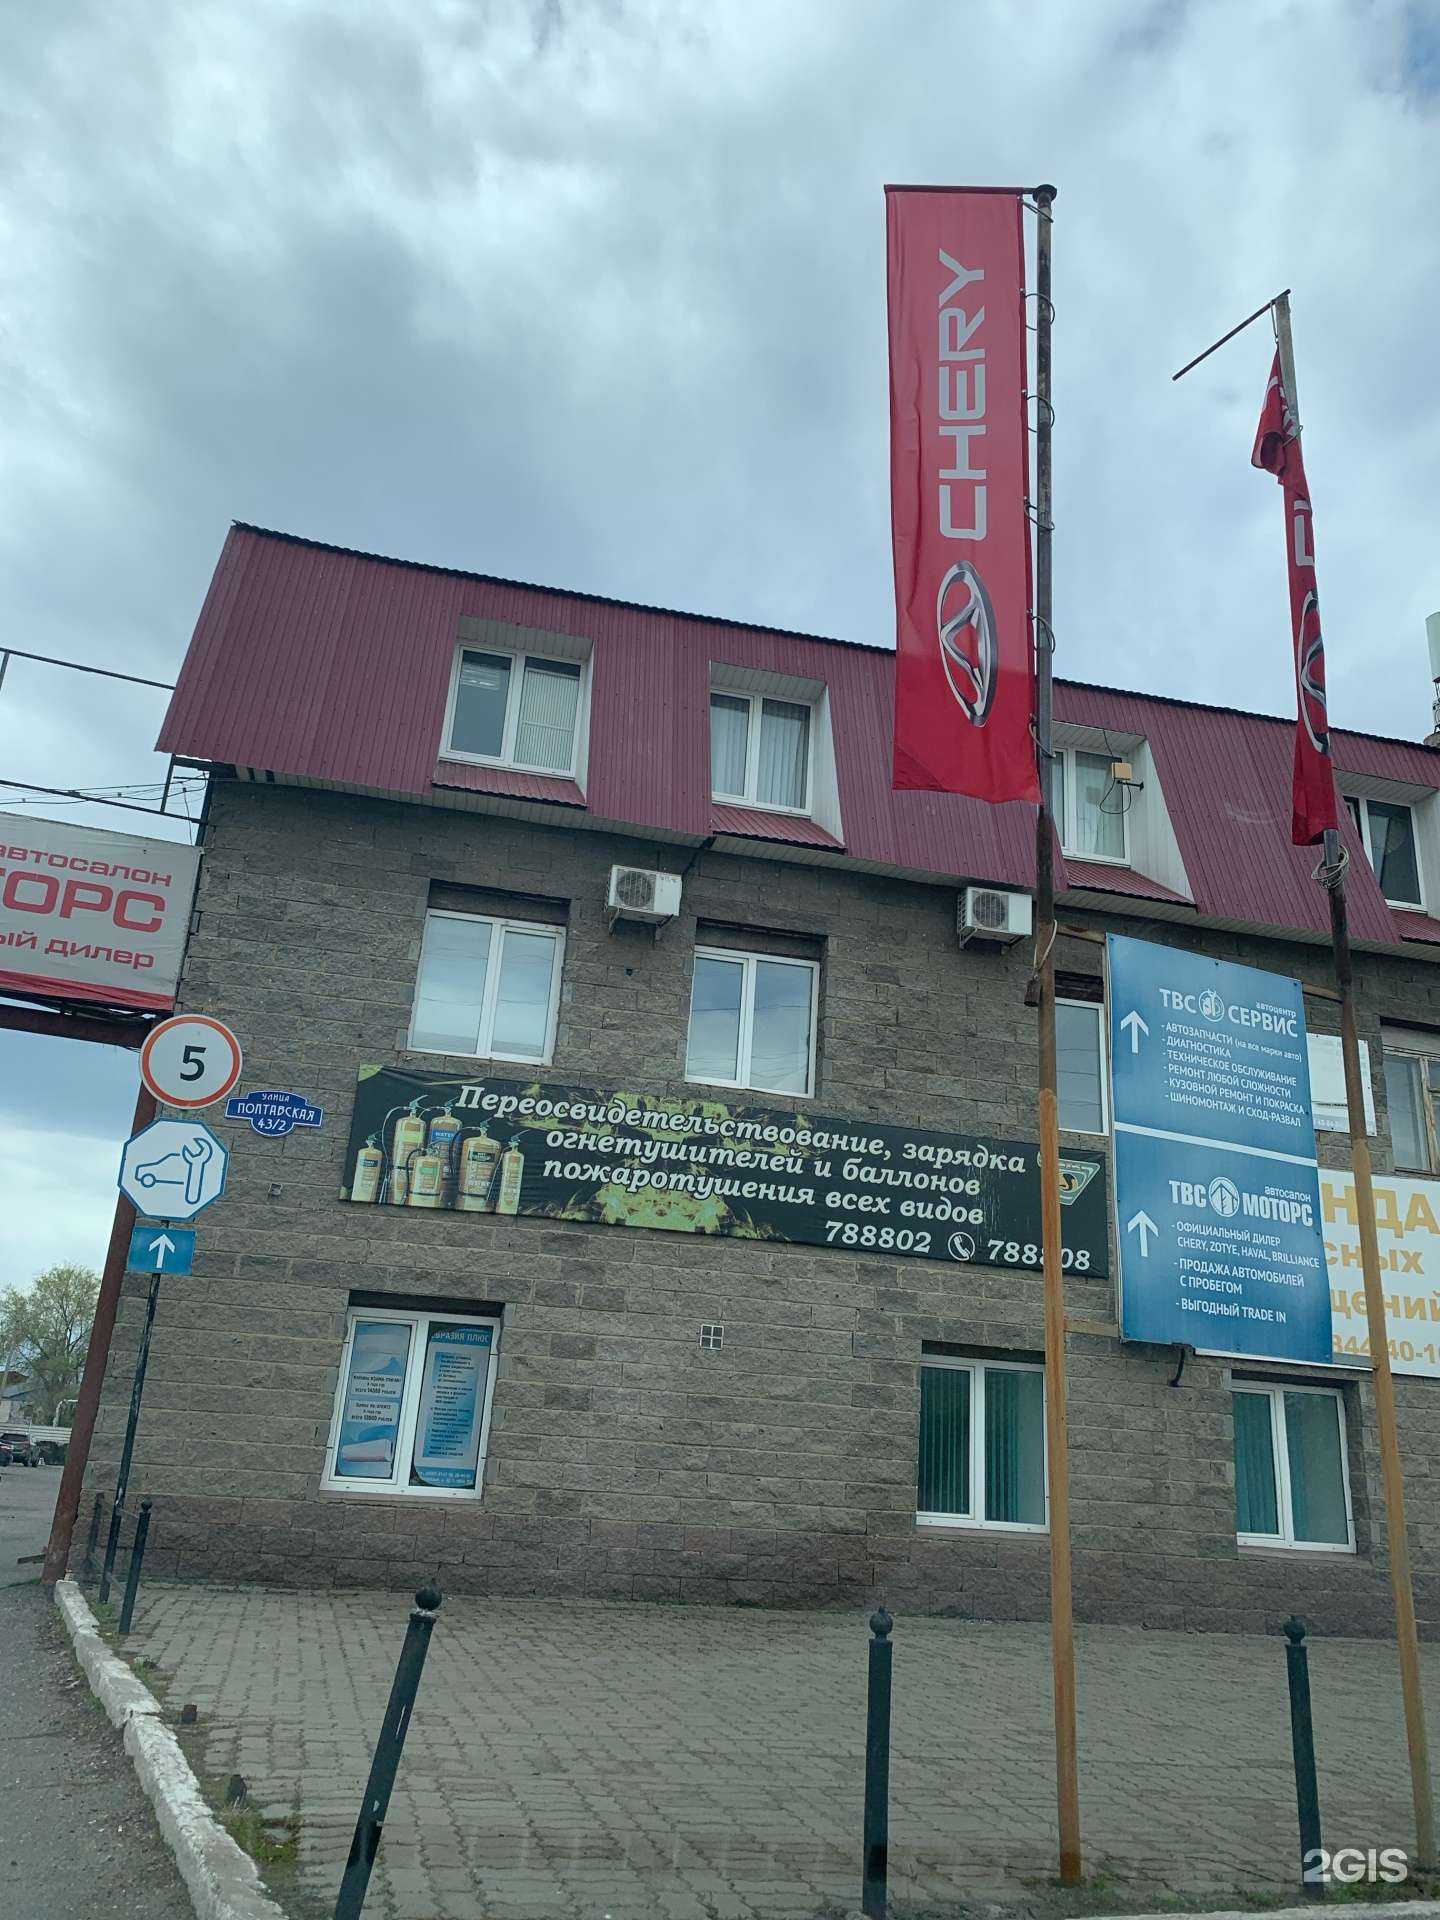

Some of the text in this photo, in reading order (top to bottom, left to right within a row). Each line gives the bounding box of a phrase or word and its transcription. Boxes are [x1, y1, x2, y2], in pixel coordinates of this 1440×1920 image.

[938, 247, 988, 541] CHERY
[0, 844, 173, 887] втосалон
[0, 867, 166, 933] ОРС
[44, 937, 155, 970] дилер
[1158, 988, 1299, 1038] ТВС СЕРВИС
[1255, 1001, 1297, 1019] автоцентр
[1166, 1022, 1233, 1044] АВТОЗАПЧАСТИ
[1166, 1036, 1232, 1059] ДИАГНОСТИКА
[179, 1045, 207, 1081] 5
[1167, 1049, 1297, 1087] ТЕХНИЧЕСКОЕ ОБСЛУЖИВАНИЕ
[1168, 1063, 1291, 1098] РЕМОНТ ЛЮБОЙ СЛОЖНОСТИ
[237, 1102, 315, 1121] ПОЛТАВСКАЯ
[1169, 1077, 1305, 1115] КУЗОВНОЙ РЕМОНТ И ПОКРАСКА
[1170, 1091, 1236, 1113] ШИНОМОНТАЖ
[1238, 1105, 1245, 1115] И
[1246, 1106, 1302, 1128] СХОД-РАЗВАЛ
[257, 1117, 287, 1131] 43/2
[455, 1085, 1026, 1174] Переосвидетельствование, зарядка
[546, 1129, 982, 1197] огнетушителей и баллонов
[543, 1158, 984, 1225] пожаротушения всех видов
[1168, 1180, 1313, 1227] ТВС МОТОРС
[1264, 1185, 1311, 1202] автосалон
[824, 1220, 1091, 1271] 788802 78808
[1176, 1220, 1281, 1247] ОФИЦИАЛЬНЫЙ ДИЛЕР
[1177, 1236, 1320, 1269] CHERY, ZOTYE, HAVAL, BRILLIANCE
[1179, 1257, 1305, 1288] ПРОДАЖА АВТОМОБИЛЕЙ
[1179, 1274, 1243, 1295] С ПРОБЕГОМ
[1181, 1297, 1287, 1324] ВЫГОДНЫЙ TRADE IN
